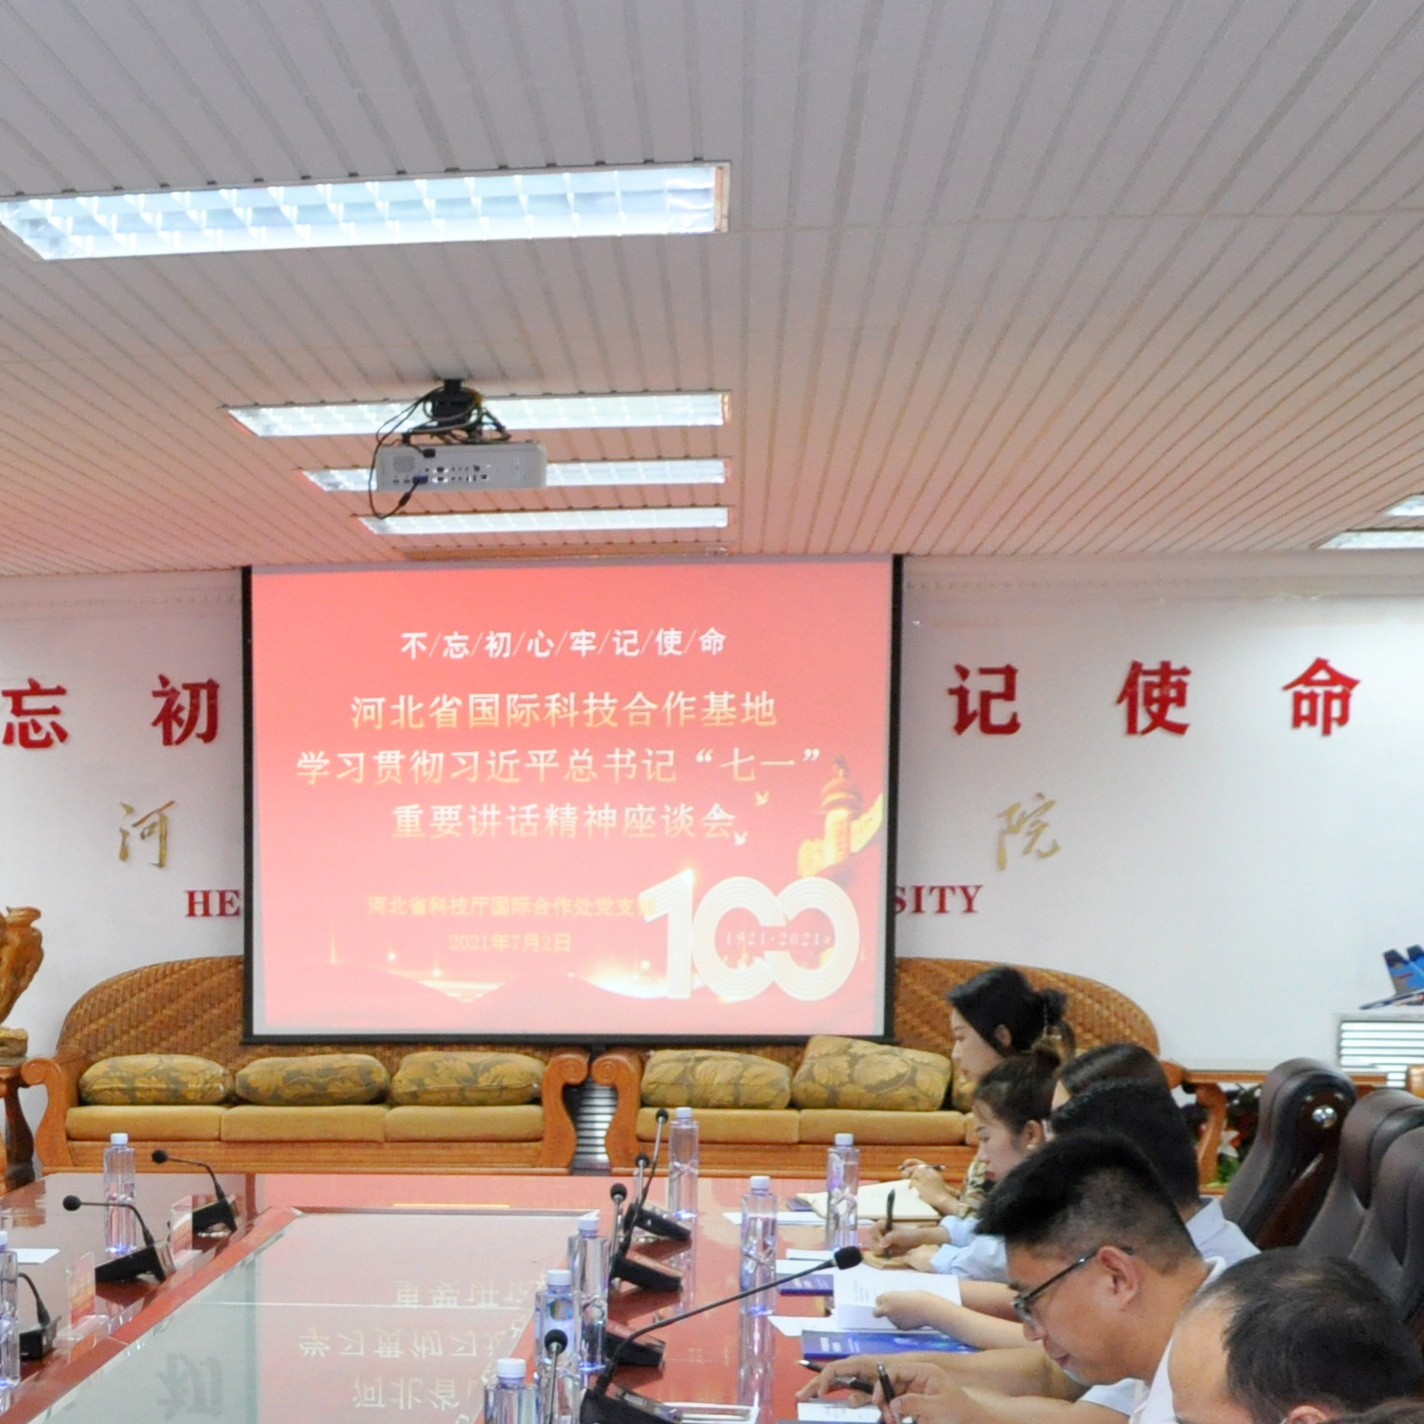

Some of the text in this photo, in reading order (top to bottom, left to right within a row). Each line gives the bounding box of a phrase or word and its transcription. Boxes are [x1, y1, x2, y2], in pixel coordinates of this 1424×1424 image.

[350, 690, 778, 730] 河北省国际科技合作基地
[118, 800, 176, 869] 河
[391, 802, 736, 840] 重要讲话精神座谈会
[185, 889, 241, 918] HE
[448, 931, 573, 953] 2021年7月2日
[638, 867, 861, 1002] 100
